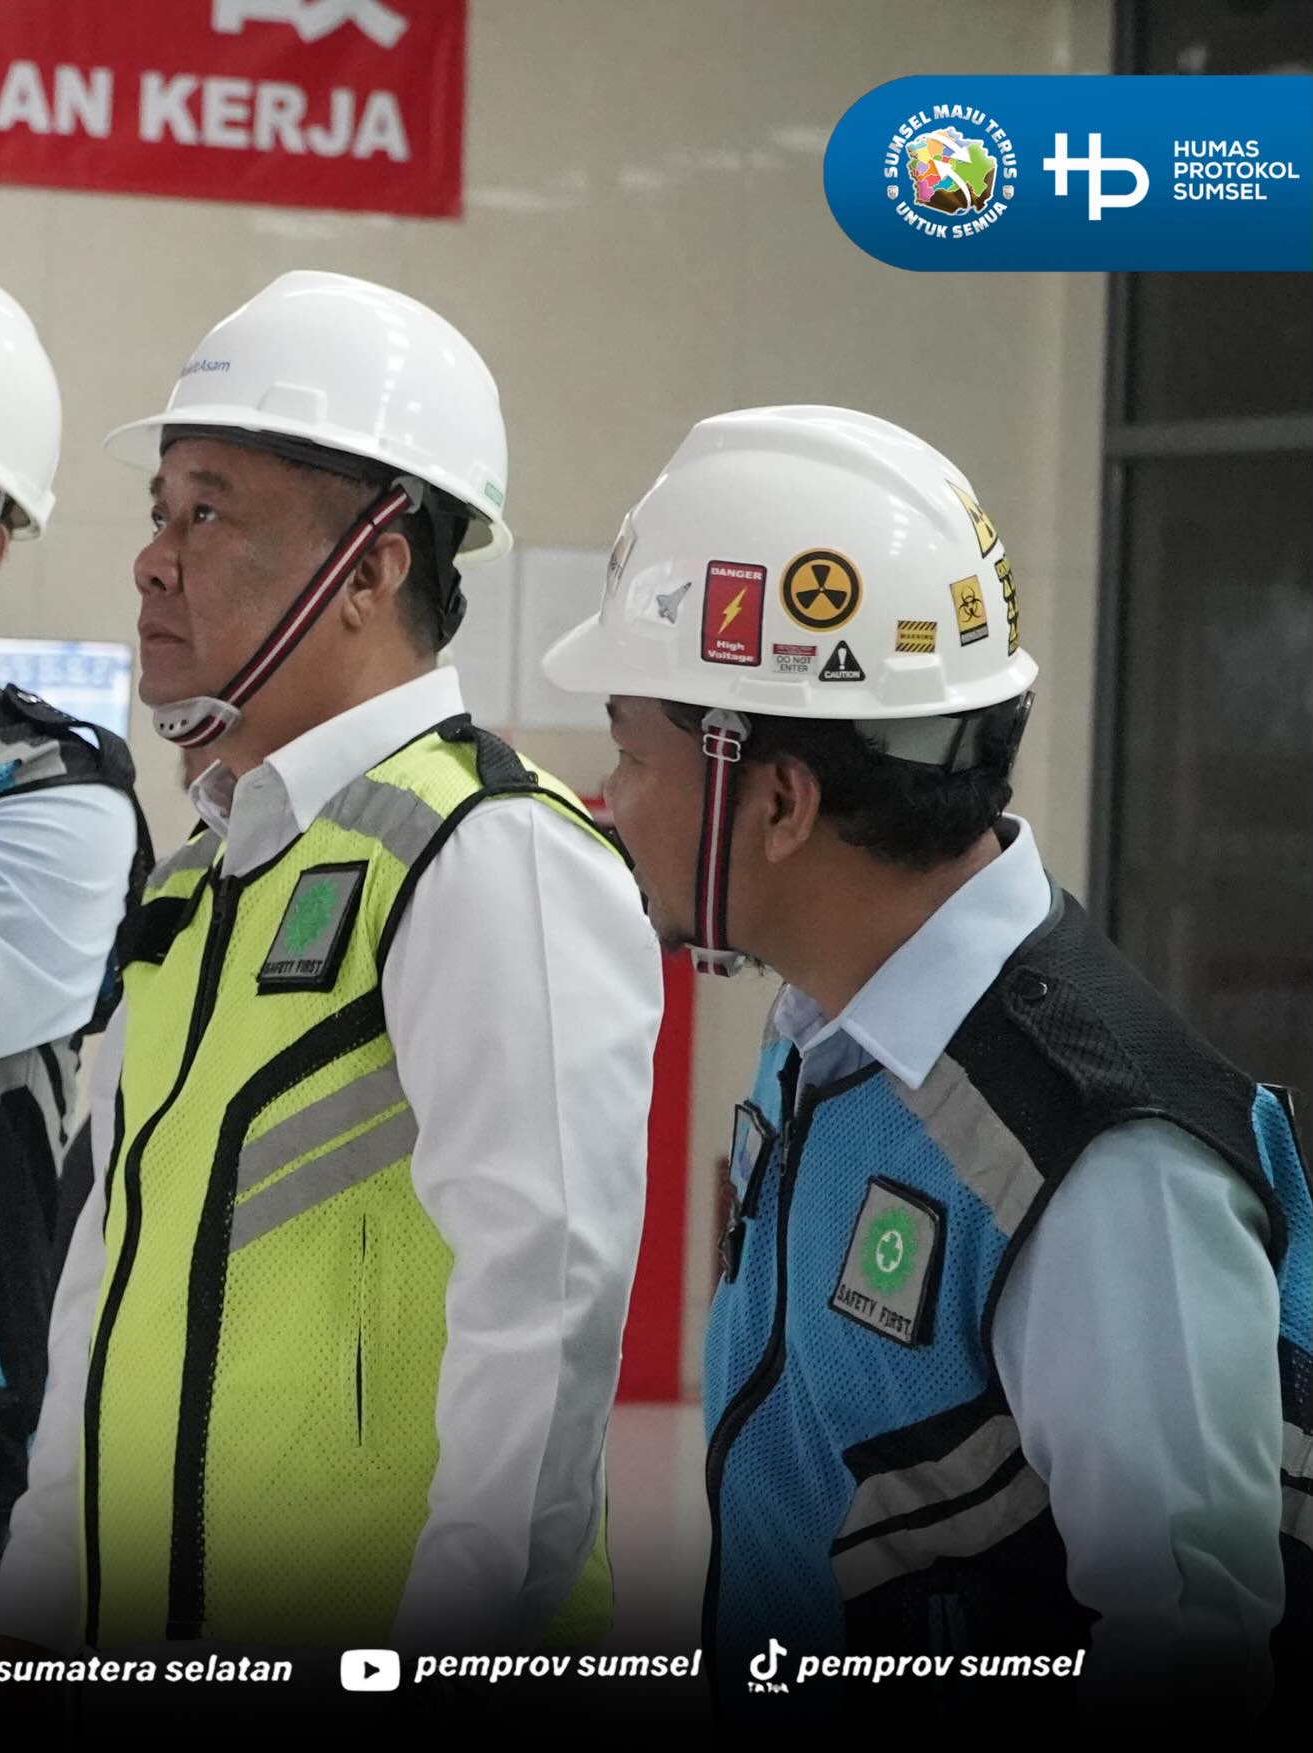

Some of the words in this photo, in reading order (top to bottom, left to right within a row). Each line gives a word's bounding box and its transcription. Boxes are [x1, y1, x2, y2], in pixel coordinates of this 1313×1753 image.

[139, 71, 411, 162] KERJA
[710, 567, 763, 580] DANGER
[716, 640, 745, 652] High
[707, 650, 755, 663] Voltage
[793, 656, 812, 665] NOT
[779, 663, 809, 673] ENTER
[823, 670, 861, 680] CAUTION
[264, 961, 296, 975] SAFETY
[295, 959, 324, 975] FIRST
[837, 1284, 879, 1317] SAFETY
[879, 1306, 912, 1336] FIRST
